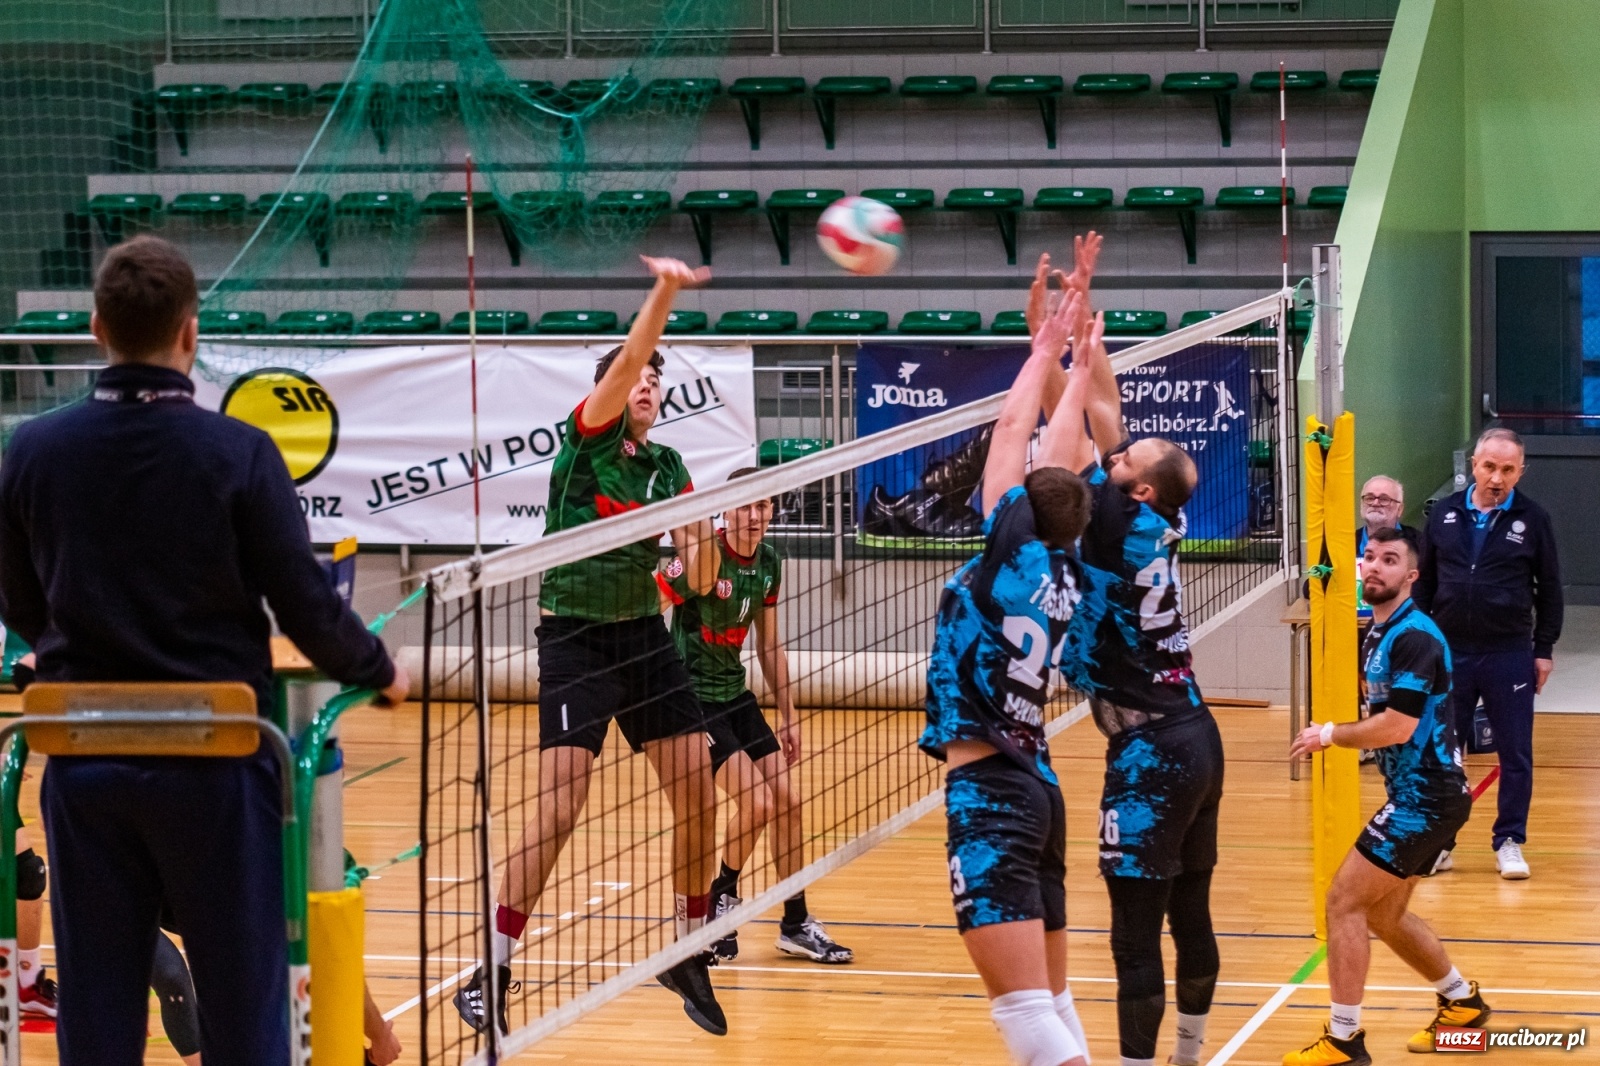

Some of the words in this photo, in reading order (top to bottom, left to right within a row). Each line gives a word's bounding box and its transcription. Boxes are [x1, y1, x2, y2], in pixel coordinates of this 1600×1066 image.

[1121, 380, 1209, 403] SPORT
[366, 457, 449, 509] JEST
[458, 444, 493, 479] W
